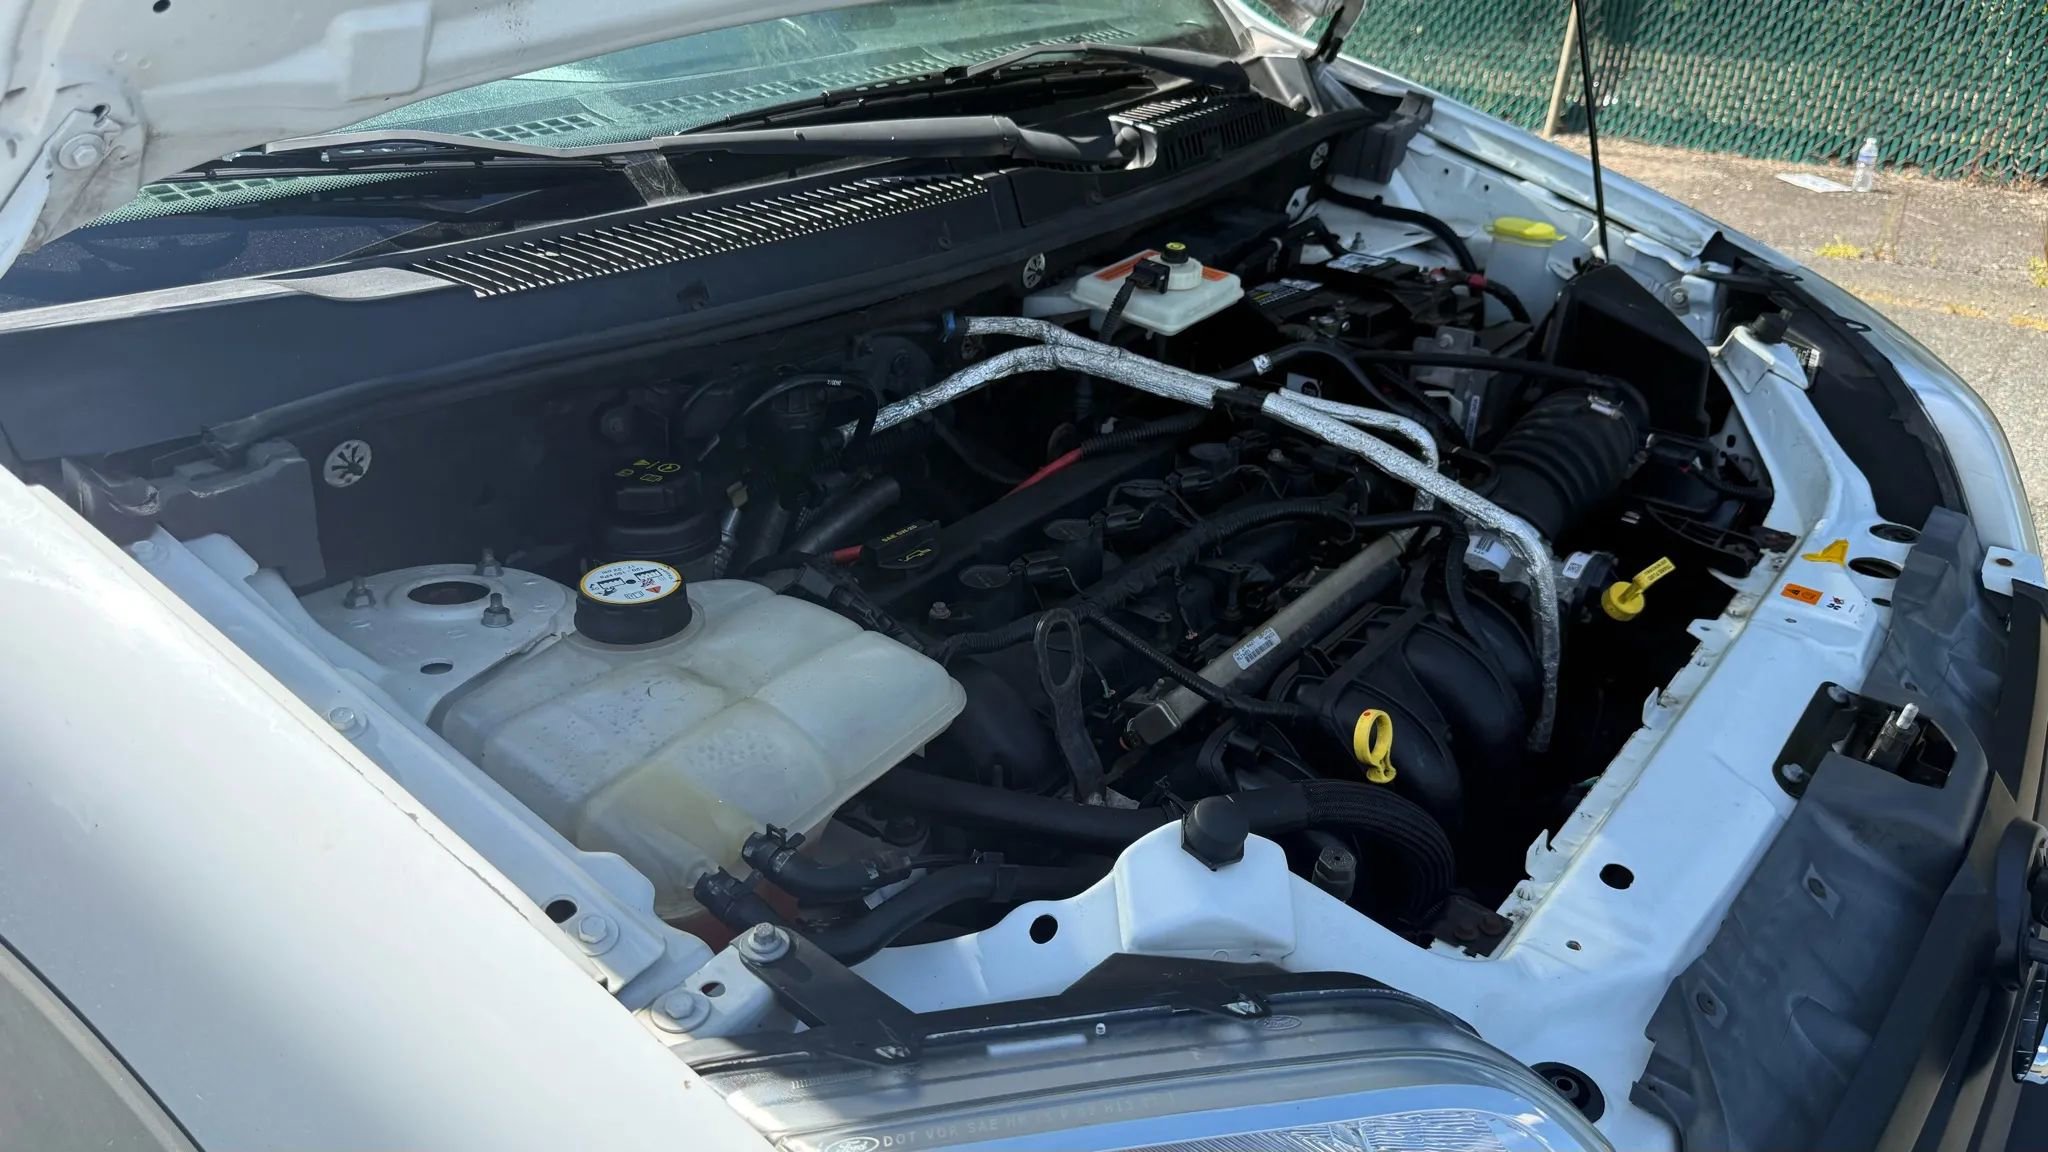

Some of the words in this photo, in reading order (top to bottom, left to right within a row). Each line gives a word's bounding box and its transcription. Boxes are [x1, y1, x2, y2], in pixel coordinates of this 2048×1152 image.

[884, 1132, 916, 1147] DOT
[926, 1125, 959, 1140] VOR
[967, 1120, 999, 1134] SAE
